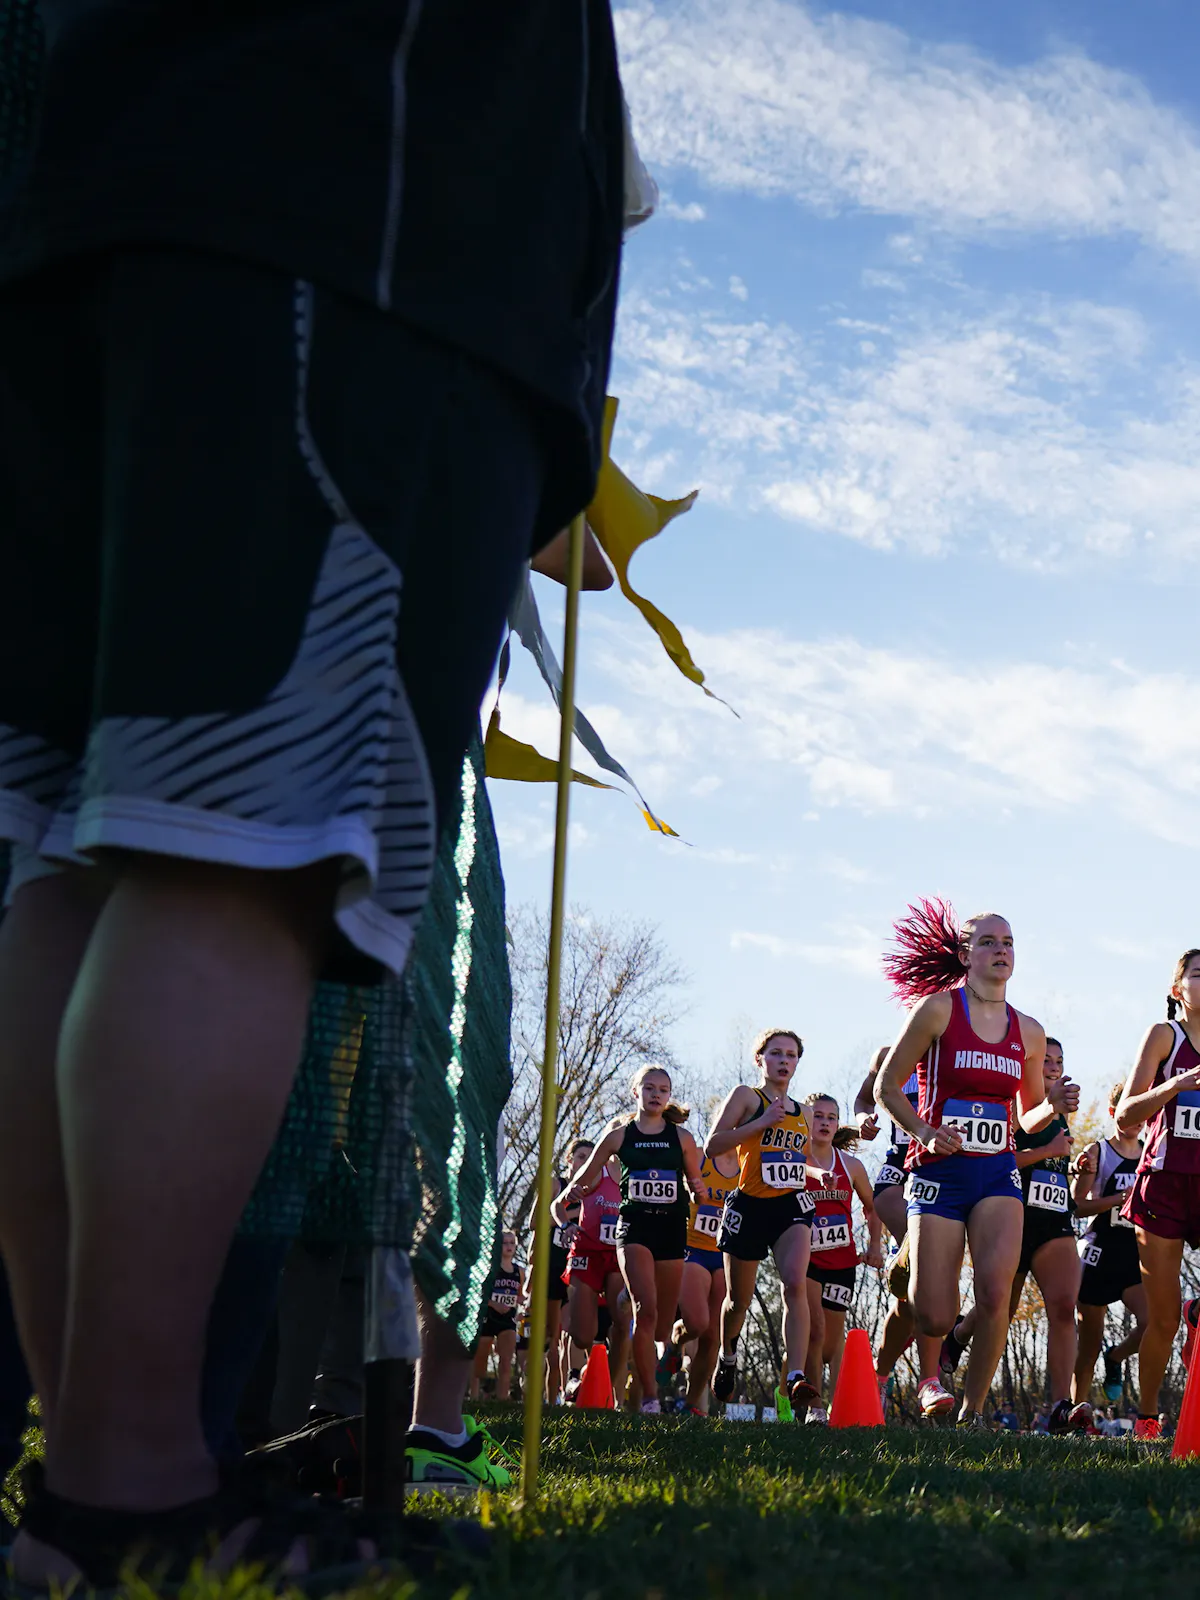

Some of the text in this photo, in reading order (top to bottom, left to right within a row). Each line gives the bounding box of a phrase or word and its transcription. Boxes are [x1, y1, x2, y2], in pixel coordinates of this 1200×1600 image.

[954, 1051, 1021, 1080] HIGHLAND
[766, 1164, 804, 1183] 1042
[633, 1181, 674, 1198] 1036
[1034, 1184, 1066, 1206] 1029
[700, 1216, 722, 1232] 10
[726, 1211, 741, 1230] 42
[811, 1226, 847, 1246] 144
